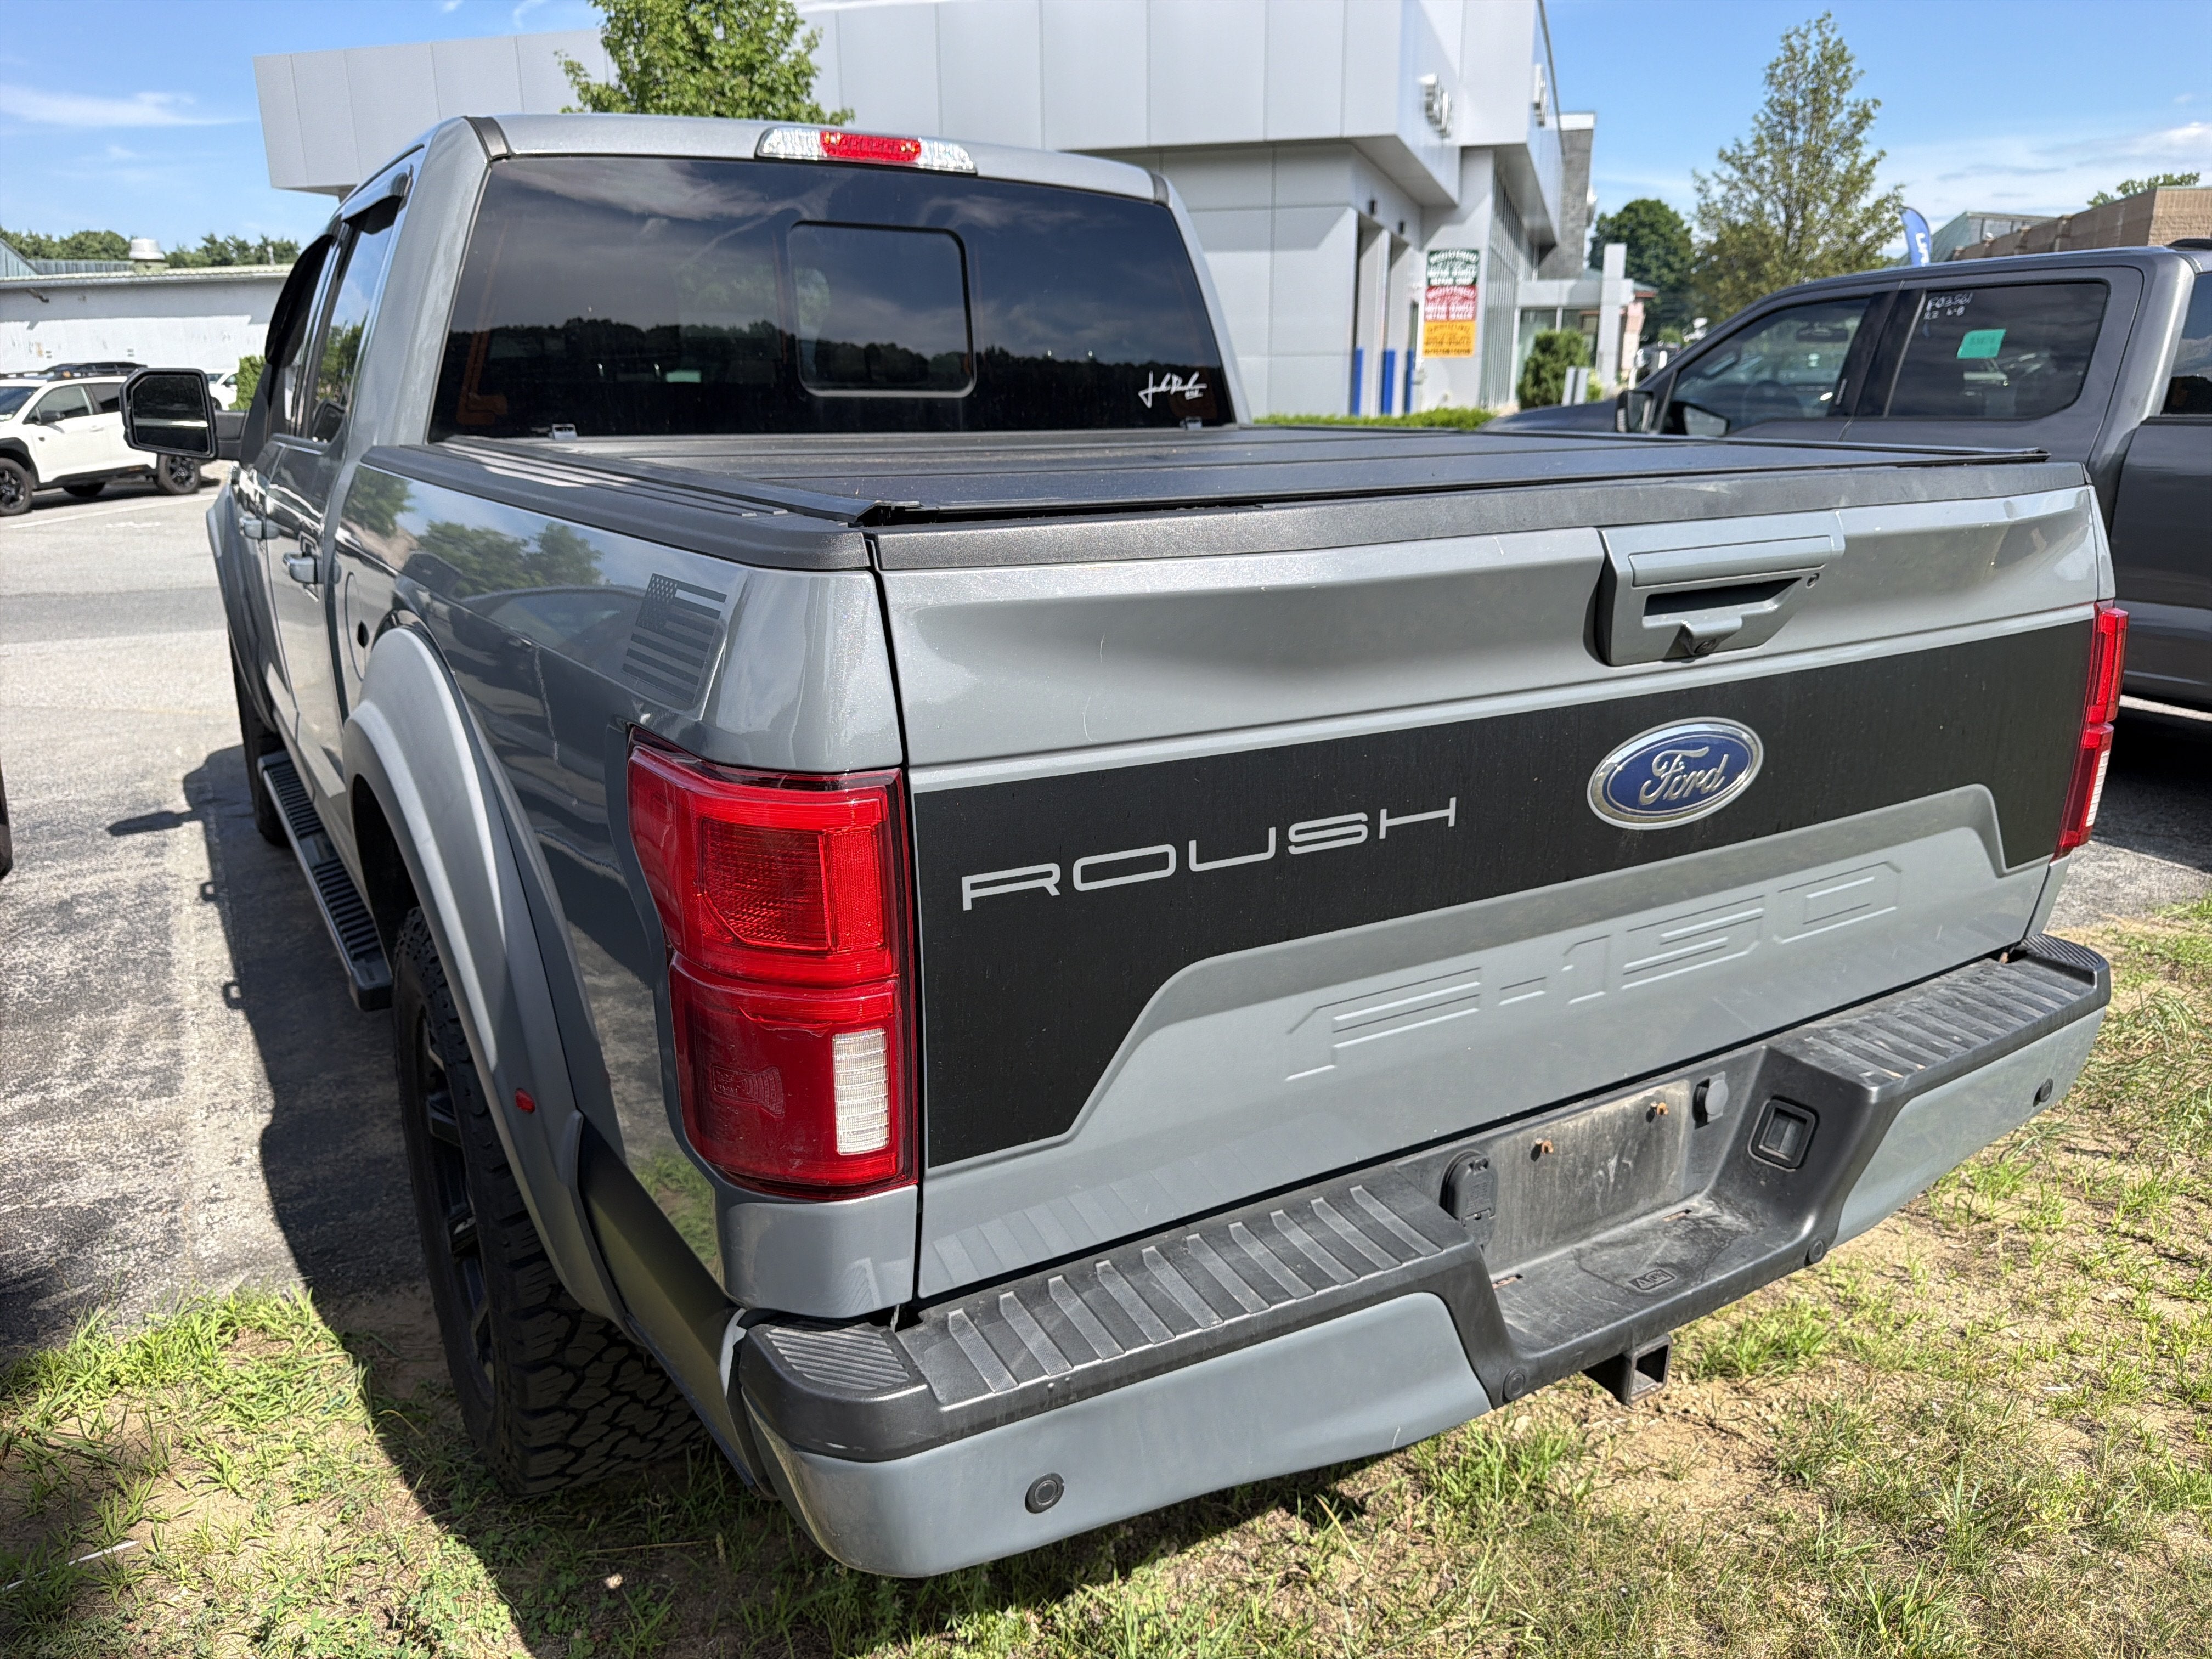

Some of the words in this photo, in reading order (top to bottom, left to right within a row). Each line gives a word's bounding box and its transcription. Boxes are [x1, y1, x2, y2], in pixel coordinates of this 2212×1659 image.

[1639, 746, 1730, 806] Ford
[961, 797, 1457, 911] ROUSH
[1286, 860, 1902, 1081] F-150
